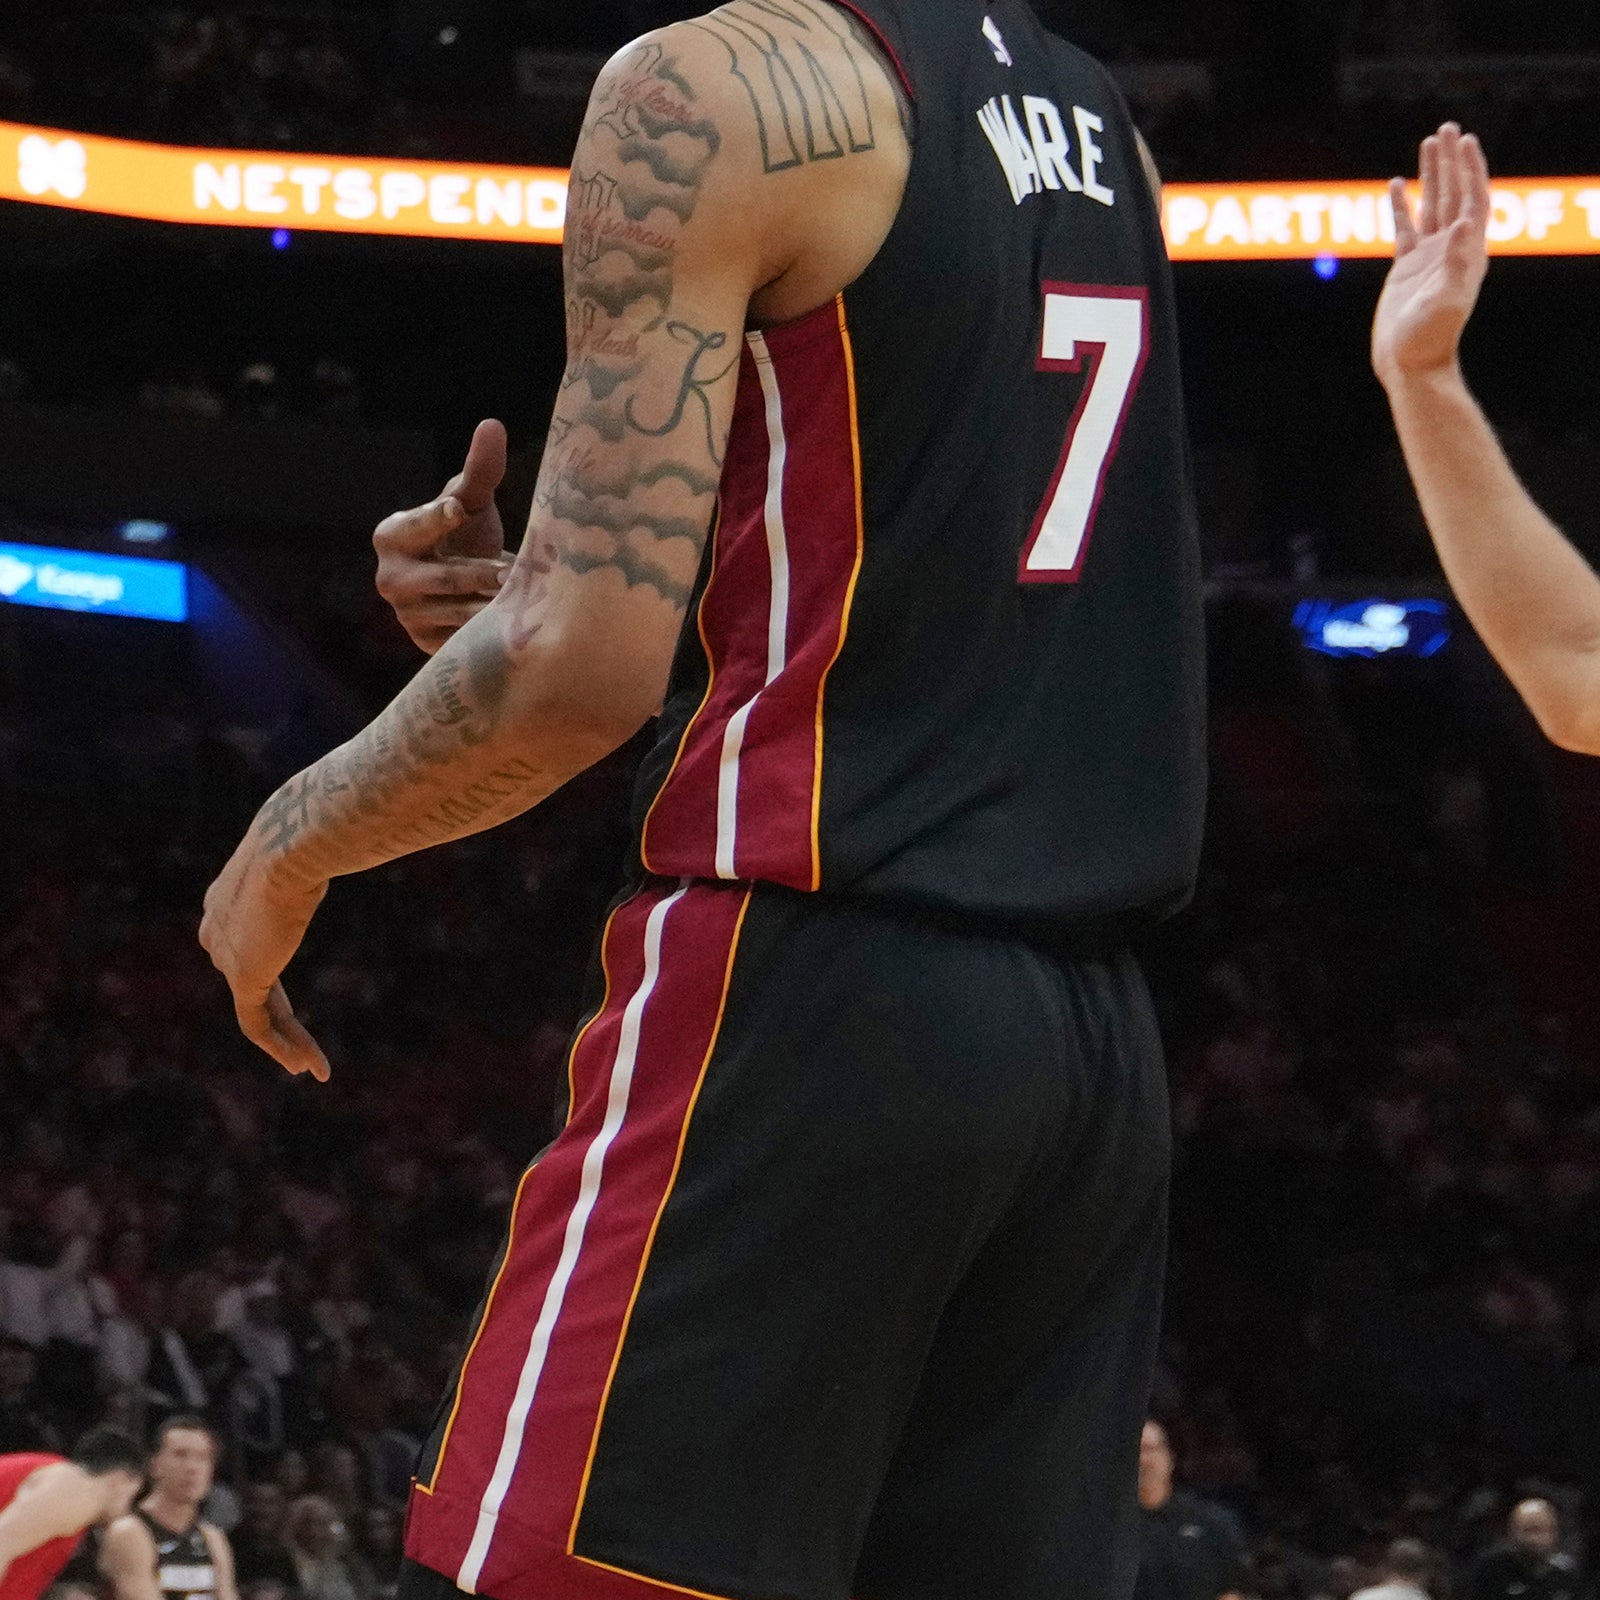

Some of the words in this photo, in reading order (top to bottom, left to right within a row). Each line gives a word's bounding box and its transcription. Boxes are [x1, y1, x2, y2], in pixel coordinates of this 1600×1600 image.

[977, 94, 1114, 206] WARE
[194, 162, 568, 229] NETSPEND
[1168, 193, 1397, 245] PARTN
[1487, 188, 1565, 242] OF
[1017, 280, 1149, 583] 7
